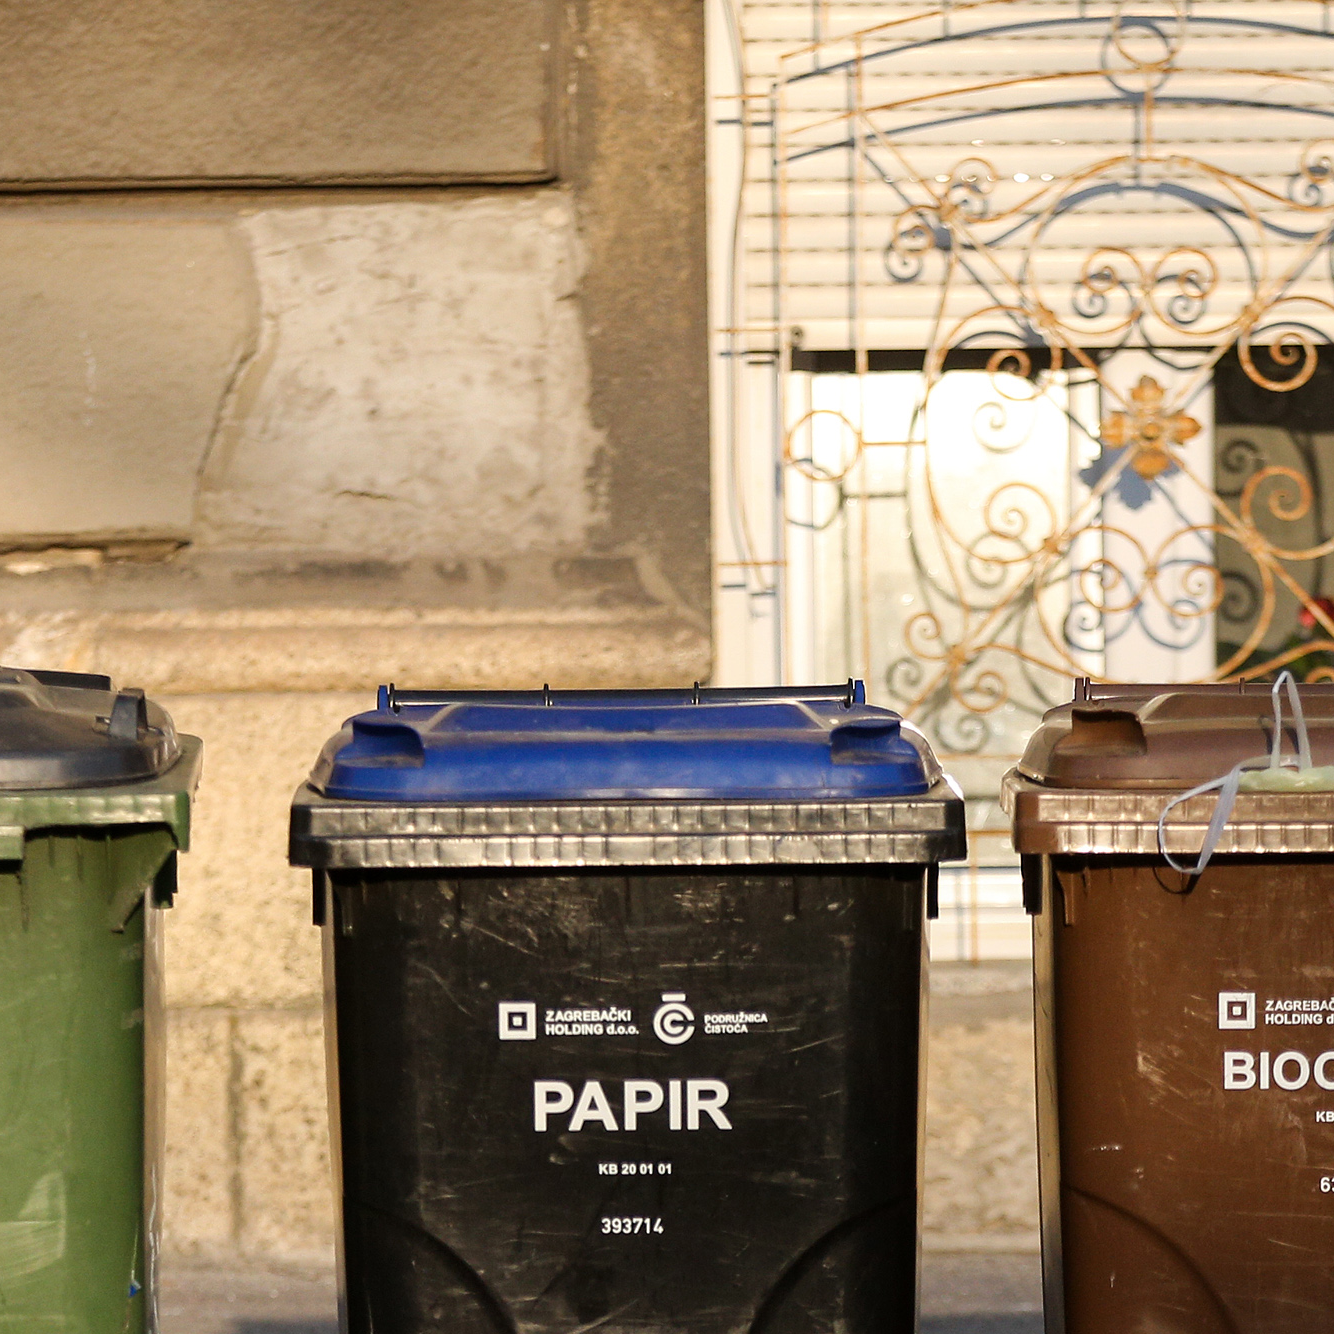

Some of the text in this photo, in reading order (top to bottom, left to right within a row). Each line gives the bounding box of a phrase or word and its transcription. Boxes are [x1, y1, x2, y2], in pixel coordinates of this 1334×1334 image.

[545, 1006, 632, 1023] ZAGREBAČKI
[703, 1011, 769, 1023] PODRUŽNICA
[1264, 1013, 1323, 1025] HOLDING
[544, 1022, 640, 1036] HOLDING d.o.o.
[704, 1022, 749, 1034] ČISTOĆA
[533, 1079, 733, 1132] PAPIR
[598, 1163, 672, 1175] KB 20 01 01
[601, 1217, 664, 1234] 393714
